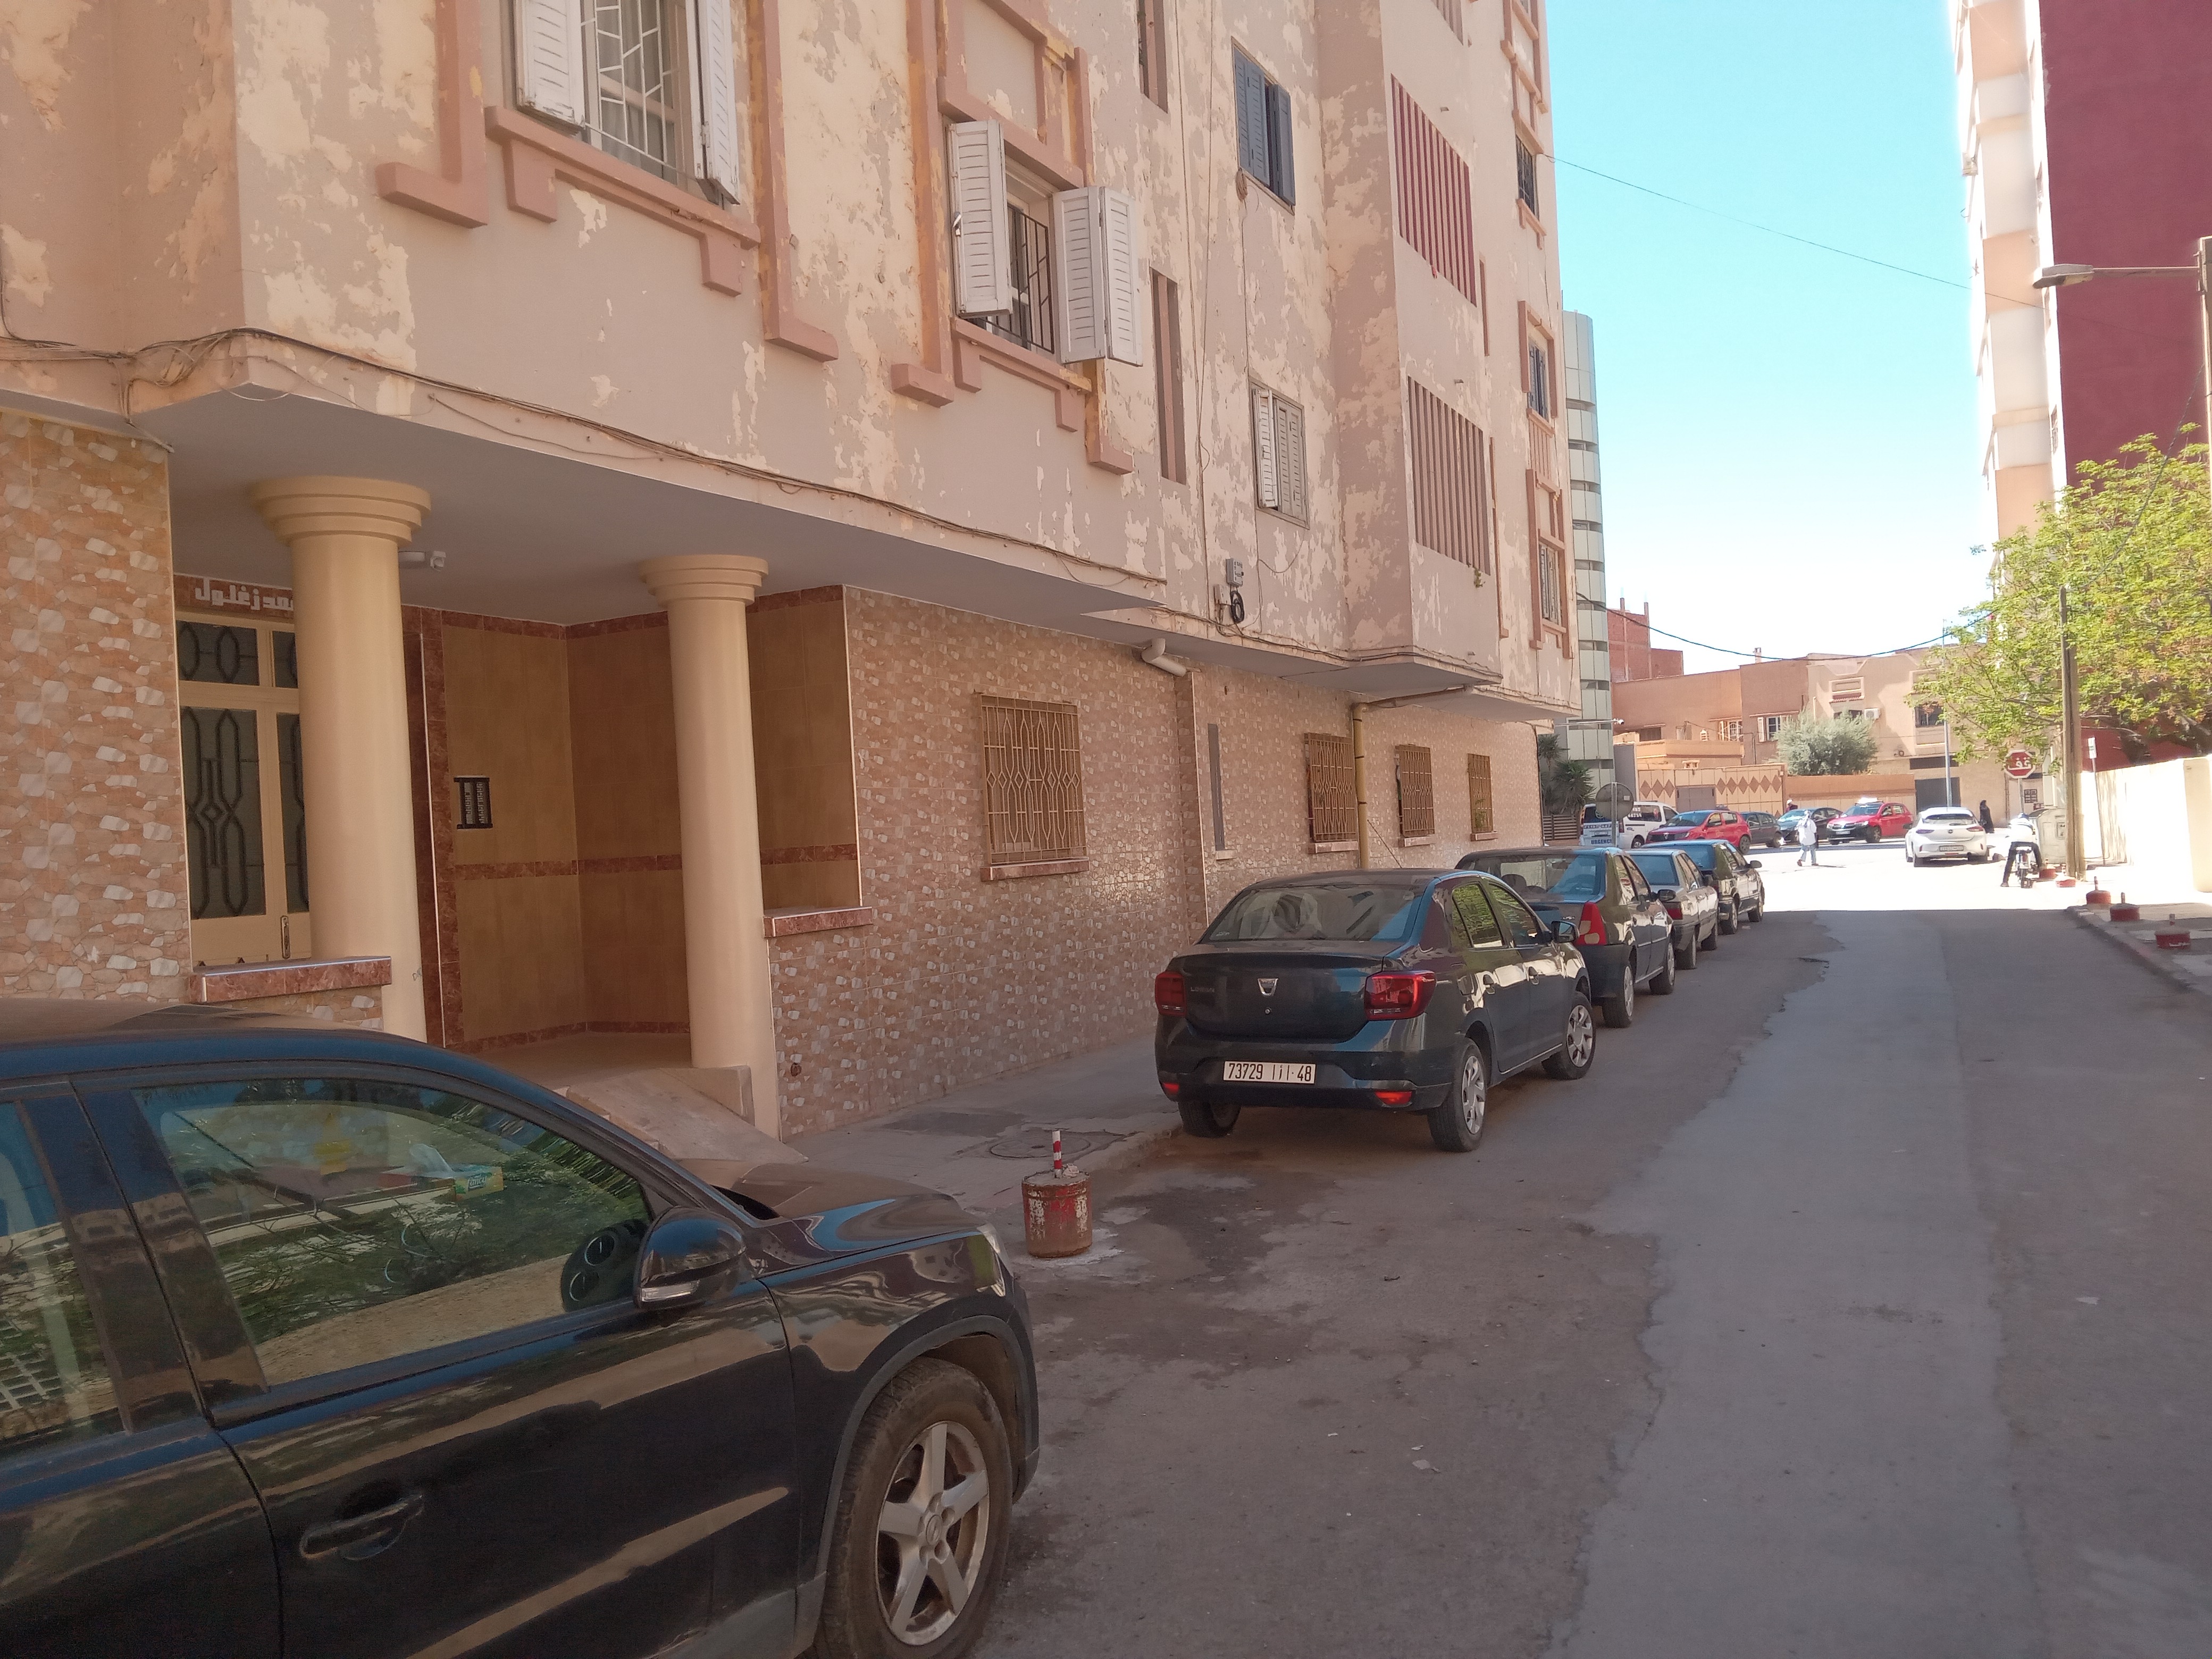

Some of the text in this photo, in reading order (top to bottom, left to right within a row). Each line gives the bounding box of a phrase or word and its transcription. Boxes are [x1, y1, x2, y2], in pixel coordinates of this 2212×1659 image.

[195, 577, 294, 611] عد زغلول
[2007, 757, 2032, 770] قف
[1228, 1063, 1263, 1080] 73729
[1297, 1066, 1312, 1082] 48
